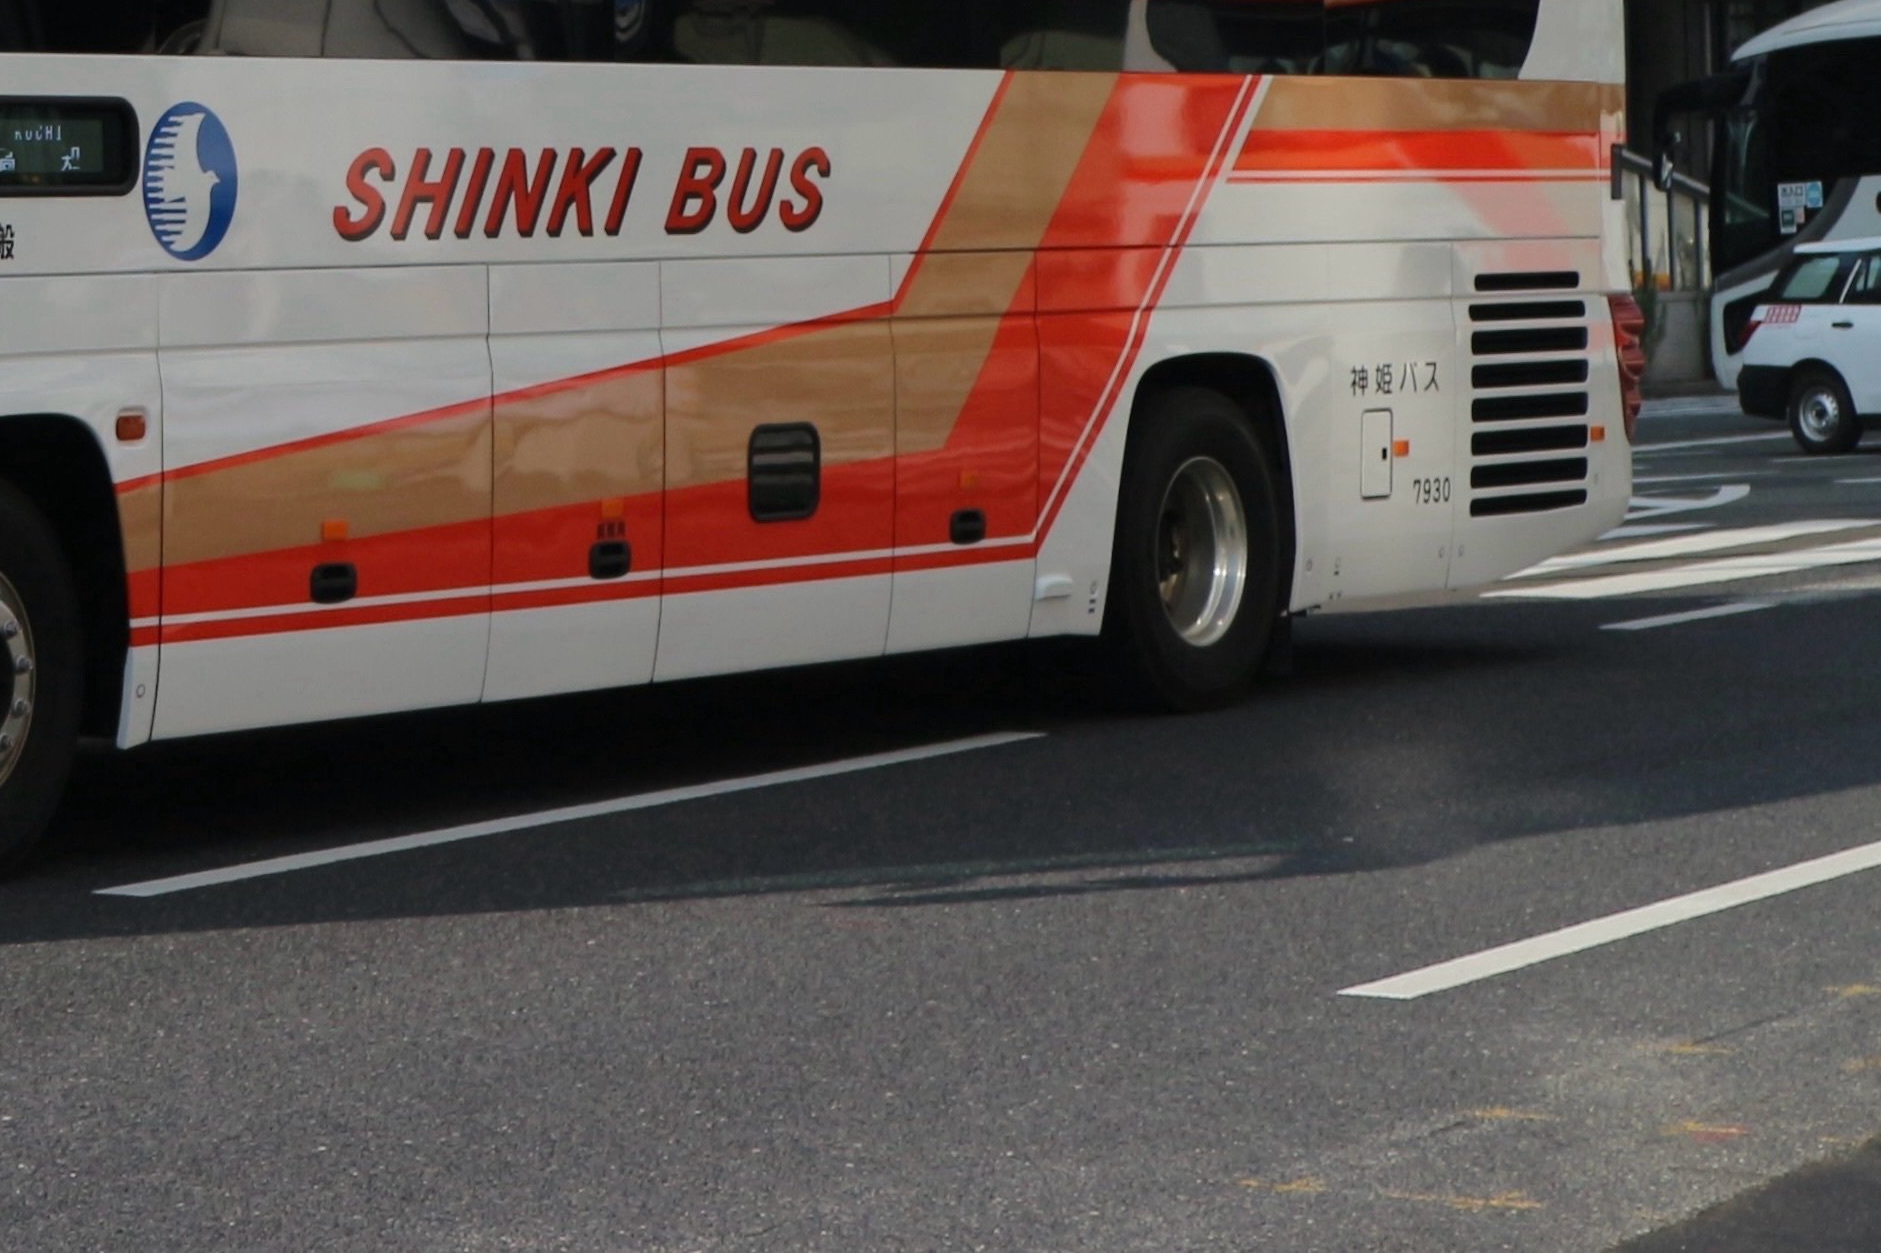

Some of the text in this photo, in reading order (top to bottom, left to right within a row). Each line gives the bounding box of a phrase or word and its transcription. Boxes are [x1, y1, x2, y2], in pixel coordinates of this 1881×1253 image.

[333, 147, 831, 242] SHINKI BUS
[1350, 361, 1440, 397] 神姫バス
[1413, 476, 1451, 505] 7930
